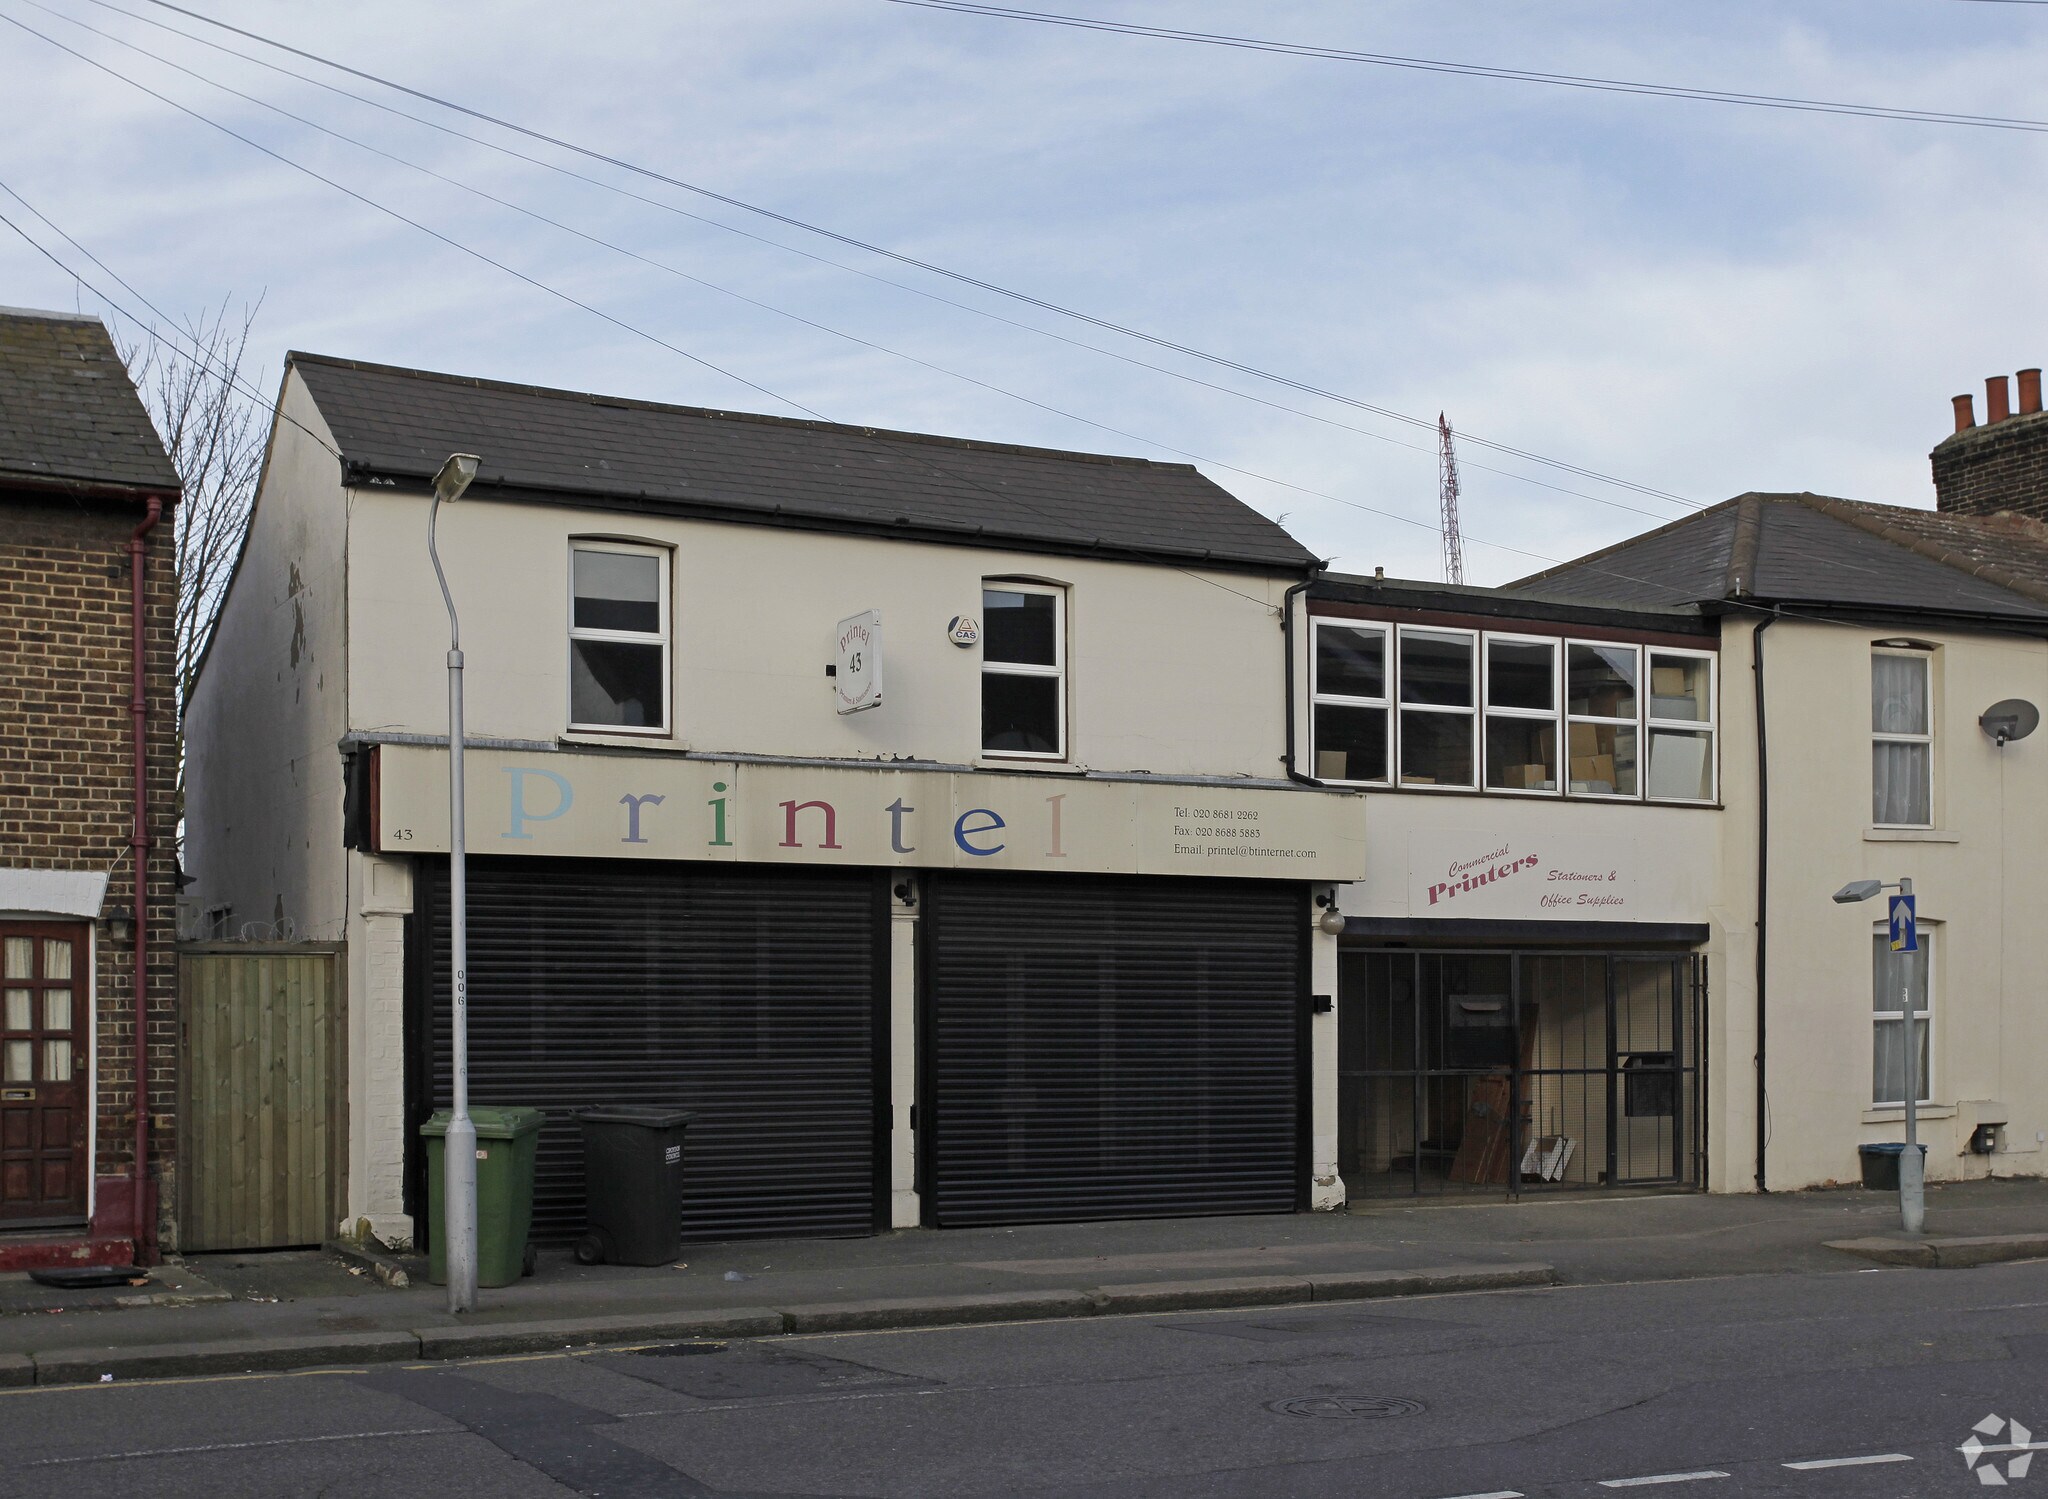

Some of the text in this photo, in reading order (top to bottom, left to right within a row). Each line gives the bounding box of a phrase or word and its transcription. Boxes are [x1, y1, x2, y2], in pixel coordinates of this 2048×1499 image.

[840, 624, 870, 654] printel
[956, 631, 976, 639] CAS
[849, 651, 862, 673] 43
[1174, 807, 1259, 821] Tel: 020 8681 2262
[393, 829, 413, 841] 43
[1174, 825, 1261, 838] Fax: 020 8688 5883
[1174, 844, 1317, 859] Email: printel@btinternet.com
[1448, 843, 1510, 878] Commercial
[1427, 852, 1539, 907] Printers
[1546, 869, 1617, 882] Stationers &
[1540, 893, 1625, 908] Office Supplies
